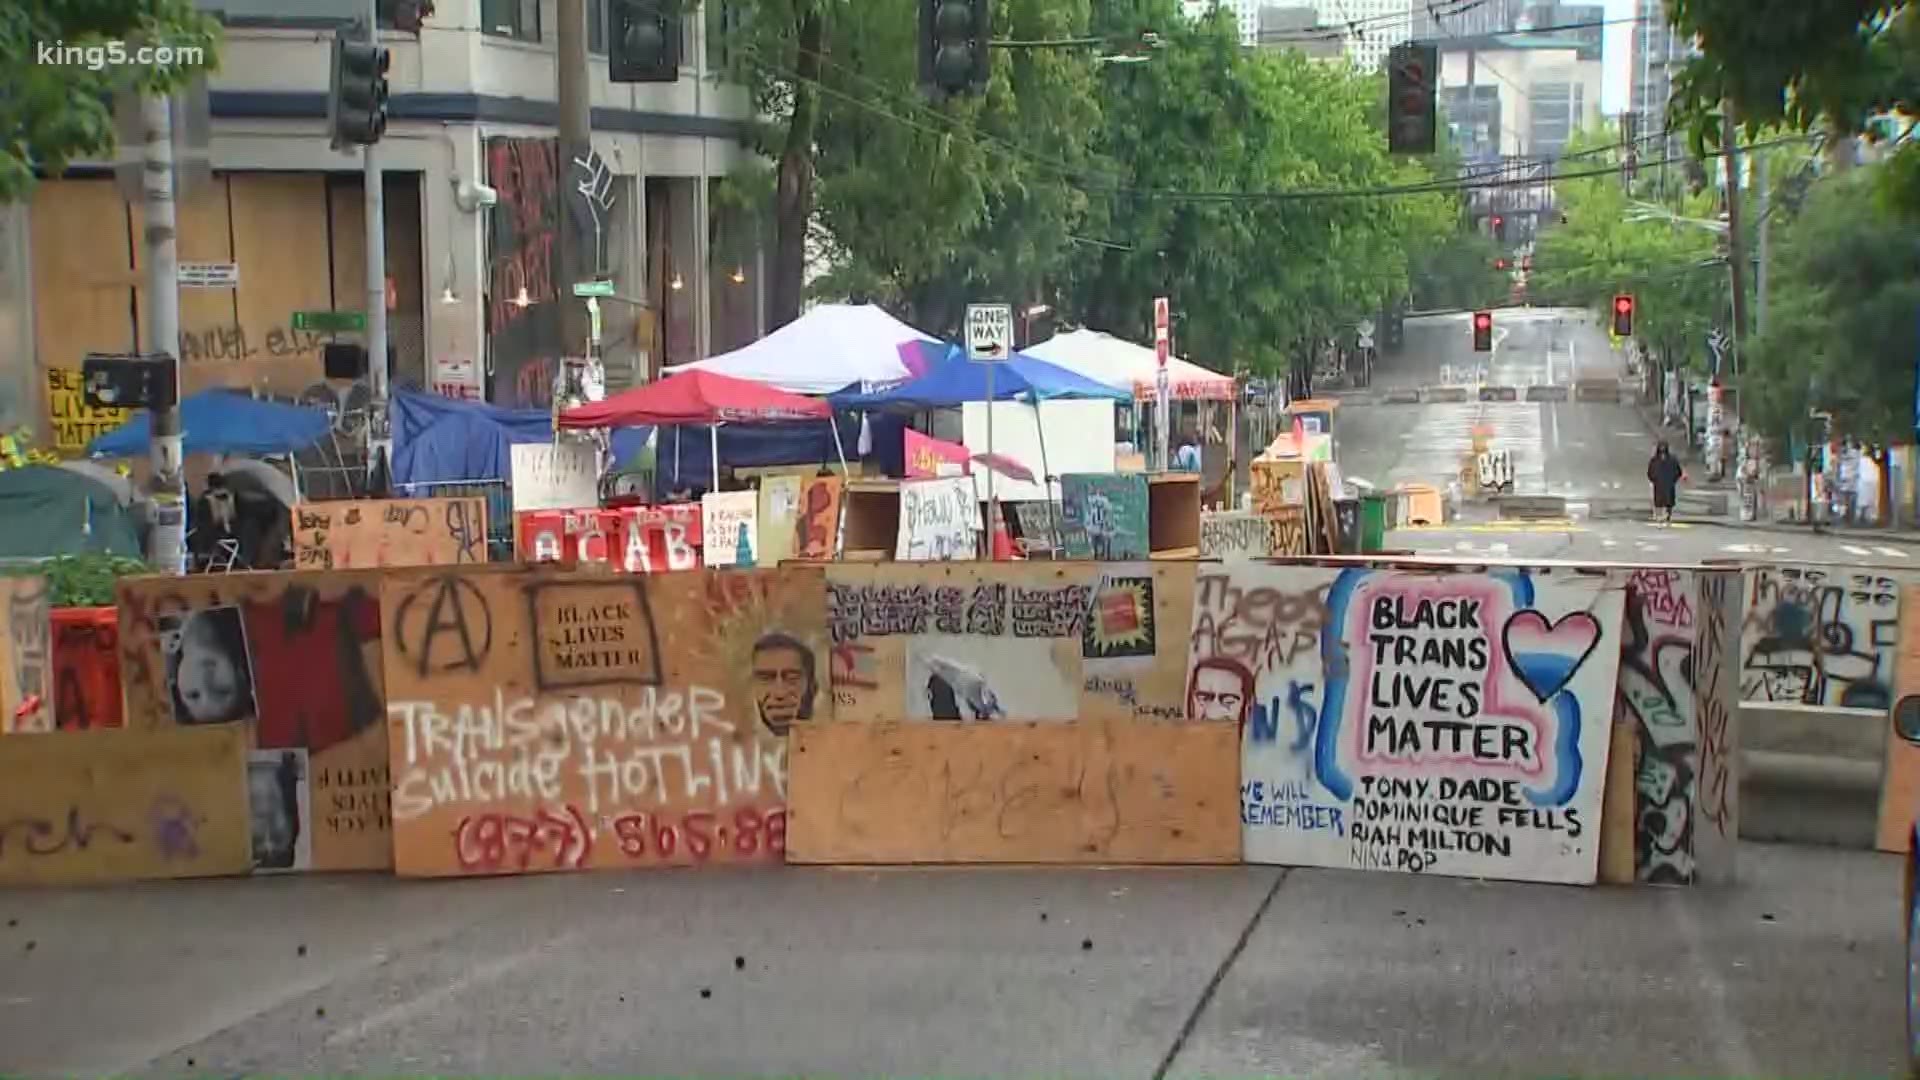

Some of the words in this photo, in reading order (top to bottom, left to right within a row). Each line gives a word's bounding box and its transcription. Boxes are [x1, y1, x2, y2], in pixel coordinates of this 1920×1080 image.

[974, 309, 1005, 323] ONE
[972, 325, 1005, 339] WAY
[558, 604, 630, 624] BLACK
[1372, 597, 1481, 629] BLACK
[564, 626, 624, 645] LIVES
[556, 649, 639, 669] MATTER
[1369, 635, 1488, 671] TRANS
[1371, 671, 1481, 718] LIVES
[1367, 714, 1530, 760] MATTER
[1271, 779, 1310, 801] WILL
[1440, 777, 1521, 805] DADE
[1353, 797, 1484, 827] DOMINIQUE
[1498, 808, 1583, 838] FELLS
[1351, 822, 1401, 848] RIAH
[1407, 827, 1512, 857] MILTON
[1351, 846, 1392, 870] NINA
[1397, 847, 1438, 873] POP
